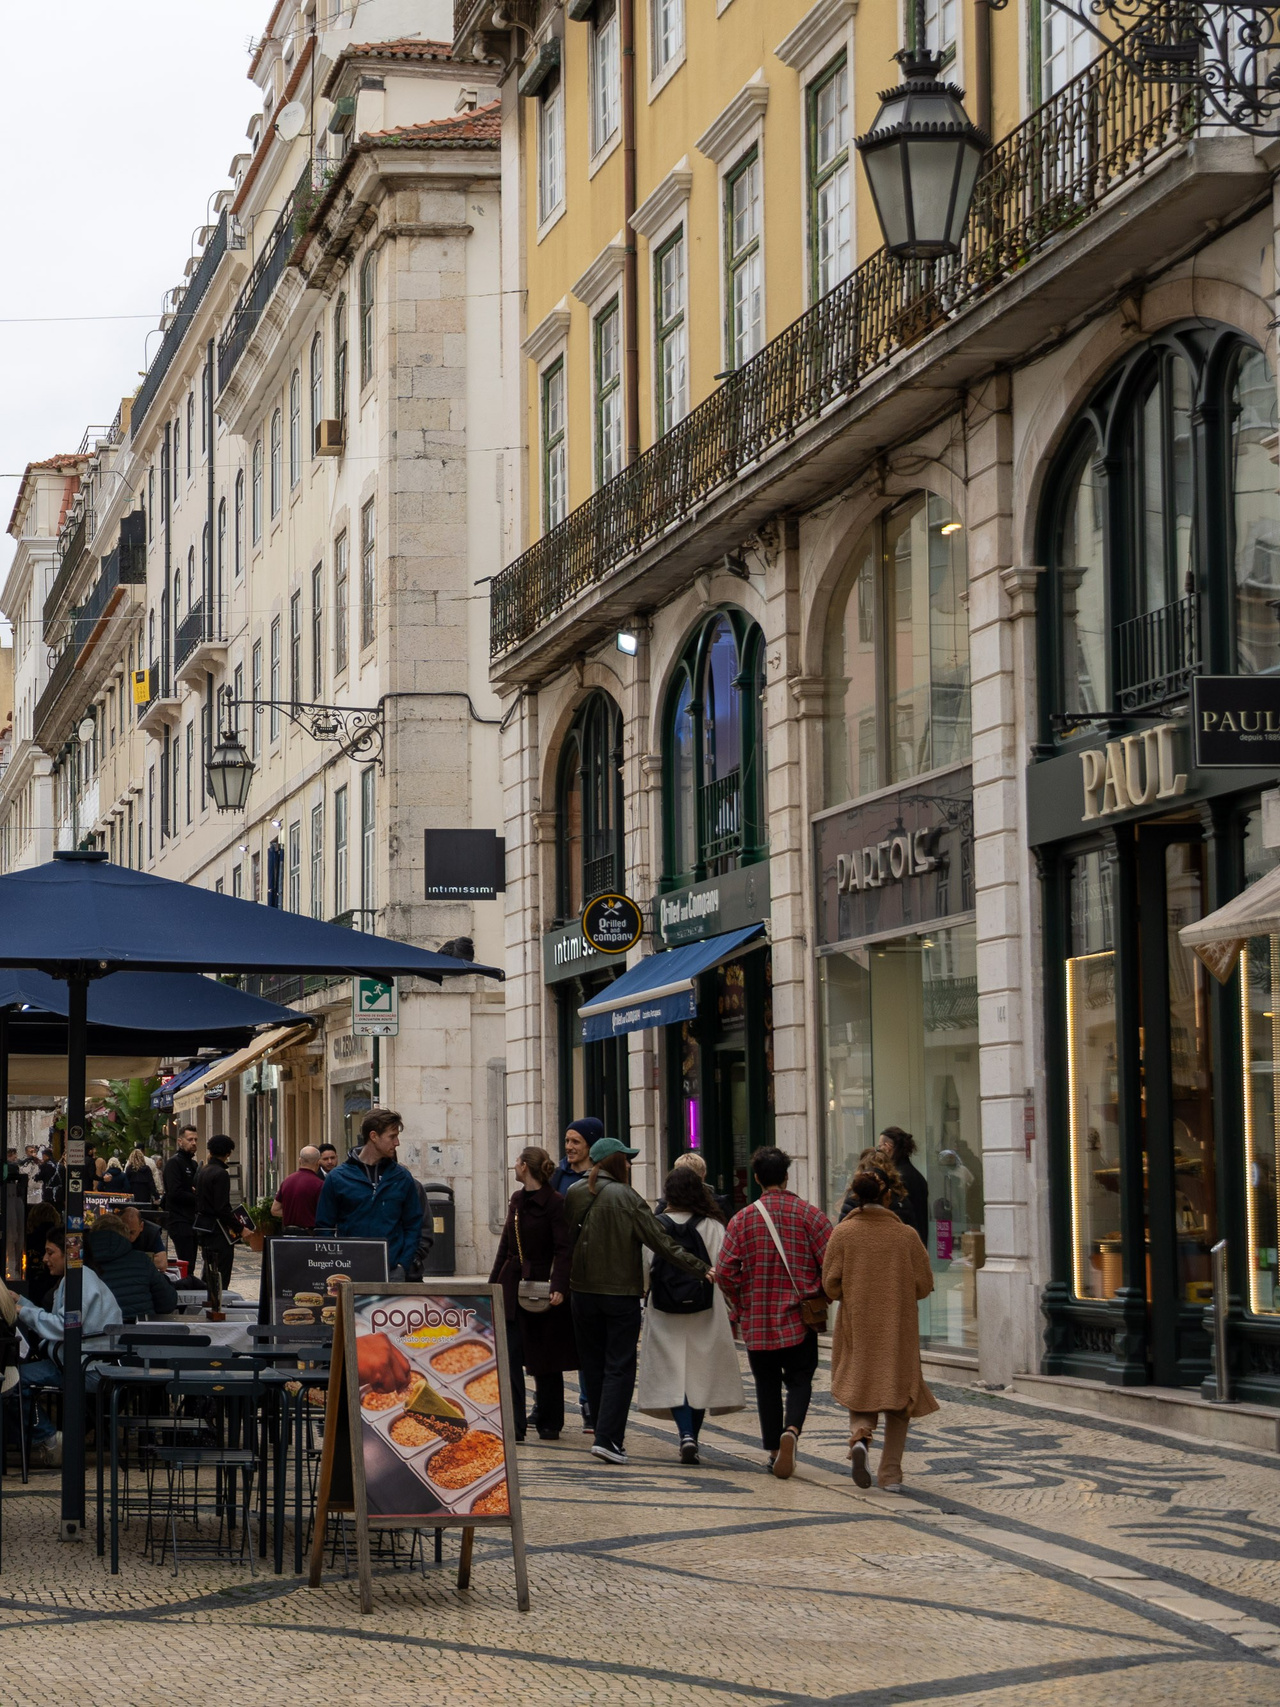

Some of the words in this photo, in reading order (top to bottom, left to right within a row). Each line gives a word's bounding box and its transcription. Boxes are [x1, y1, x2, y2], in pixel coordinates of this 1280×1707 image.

[1202, 711, 1280, 732] PAUL
[1239, 734, 1263, 742] depuis
[1079, 723, 1188, 822] PAUL
[836, 827, 937, 895] PARFOIS
[428, 886, 494, 894] intimissimi
[593, 933, 633, 942] company
[85, 1197, 108, 1205] Happy
[315, 1243, 343, 1252] PAUL
[308, 1259, 334, 1270] Burger?
[334, 1259, 351, 1268] Oui!
[371, 1303, 477, 1334] popbar
